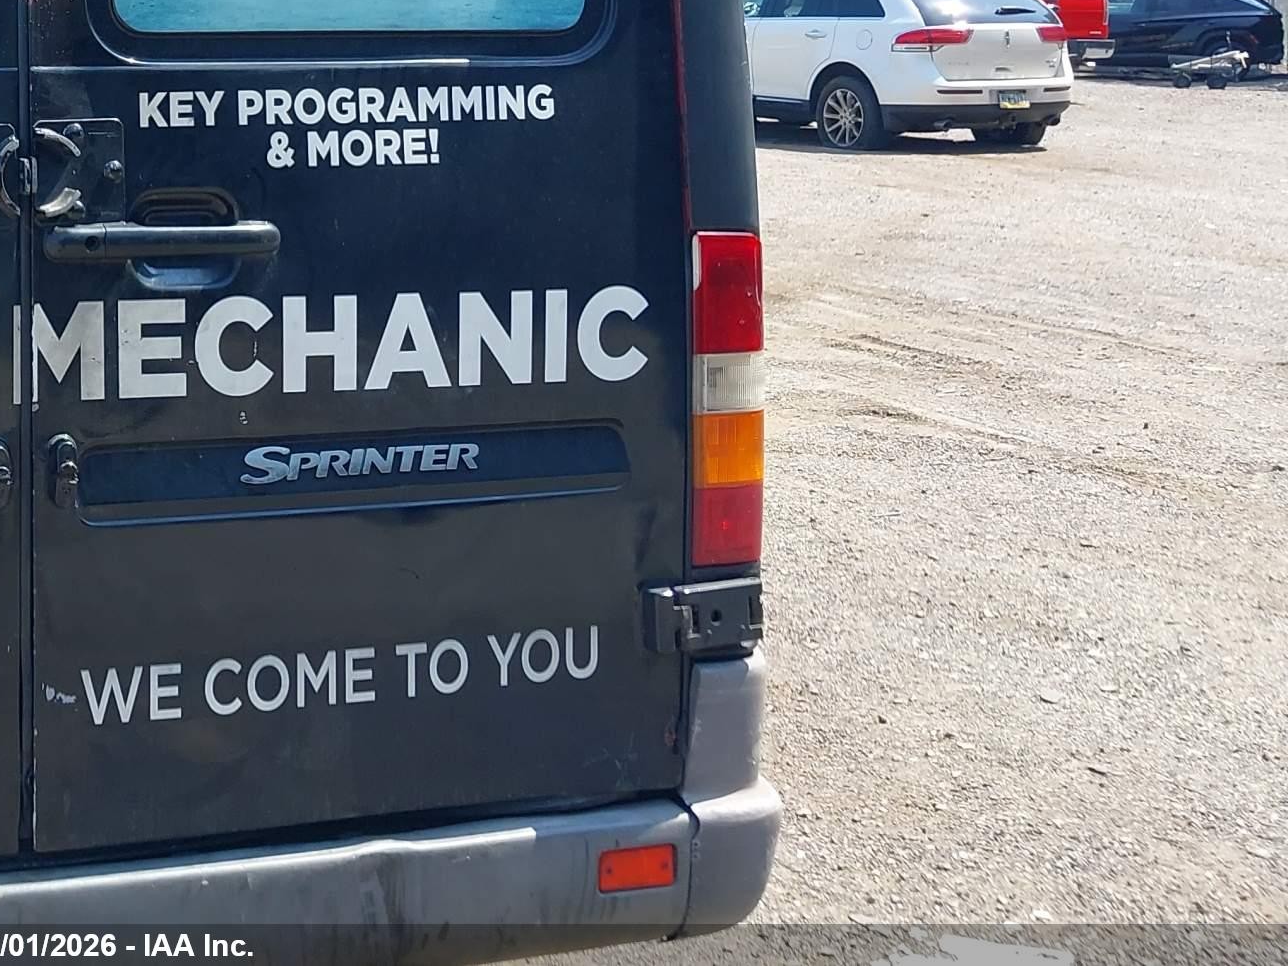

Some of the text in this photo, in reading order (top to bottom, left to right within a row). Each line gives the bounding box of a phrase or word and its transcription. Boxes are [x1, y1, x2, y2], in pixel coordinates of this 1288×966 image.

[139, 84, 556, 128] KEY PROGRAMMING
[266, 128, 440, 168] & MORE!
[13, 285, 650, 405] MECHANIC
[240, 443, 480, 485] SPRINTER
[81, 626, 599, 725] WE COME TO YOU
